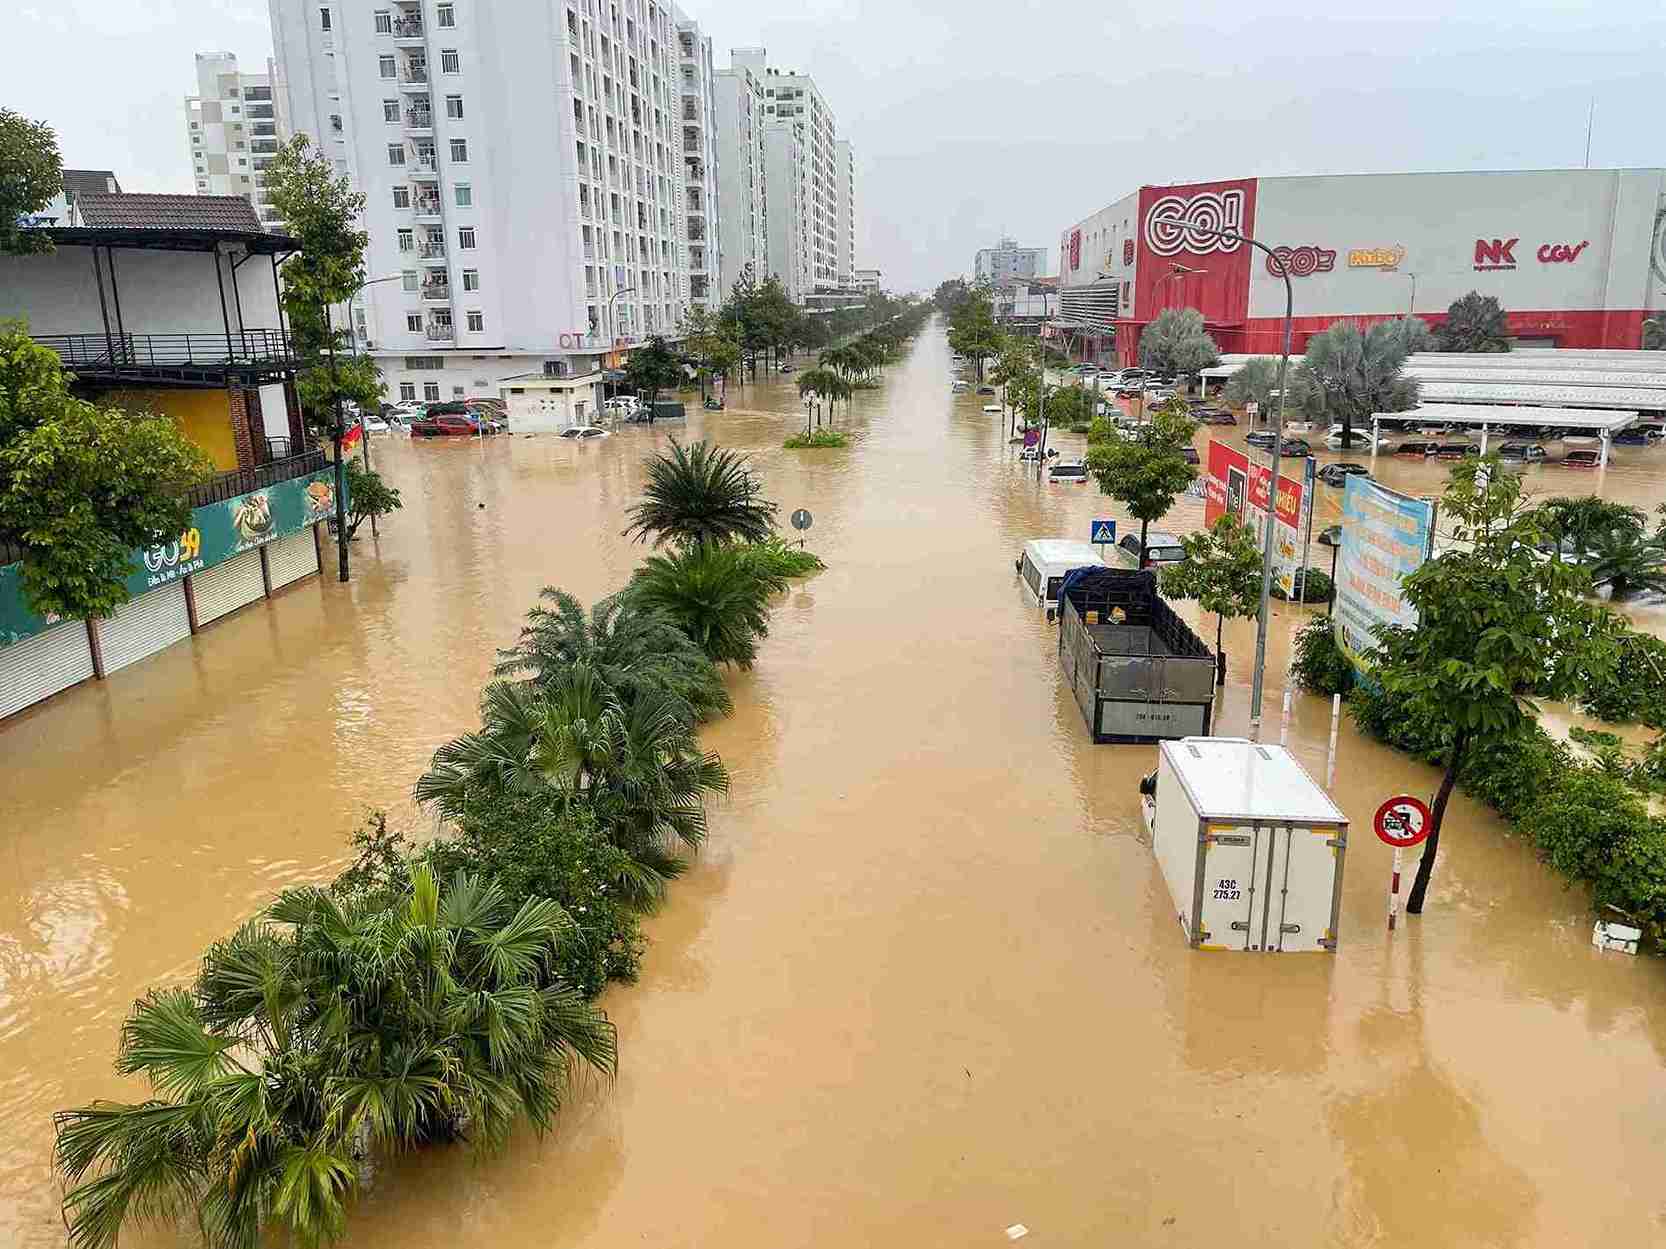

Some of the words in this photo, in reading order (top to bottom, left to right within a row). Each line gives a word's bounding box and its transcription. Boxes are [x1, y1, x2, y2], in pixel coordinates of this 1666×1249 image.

[1145, 189, 1244, 256] GO!
[1474, 238, 1520, 264] NK
[1536, 240, 1590, 263] CGV
[1213, 890, 1241, 900] 275.27
[1218, 879, 1237, 890] 43C
